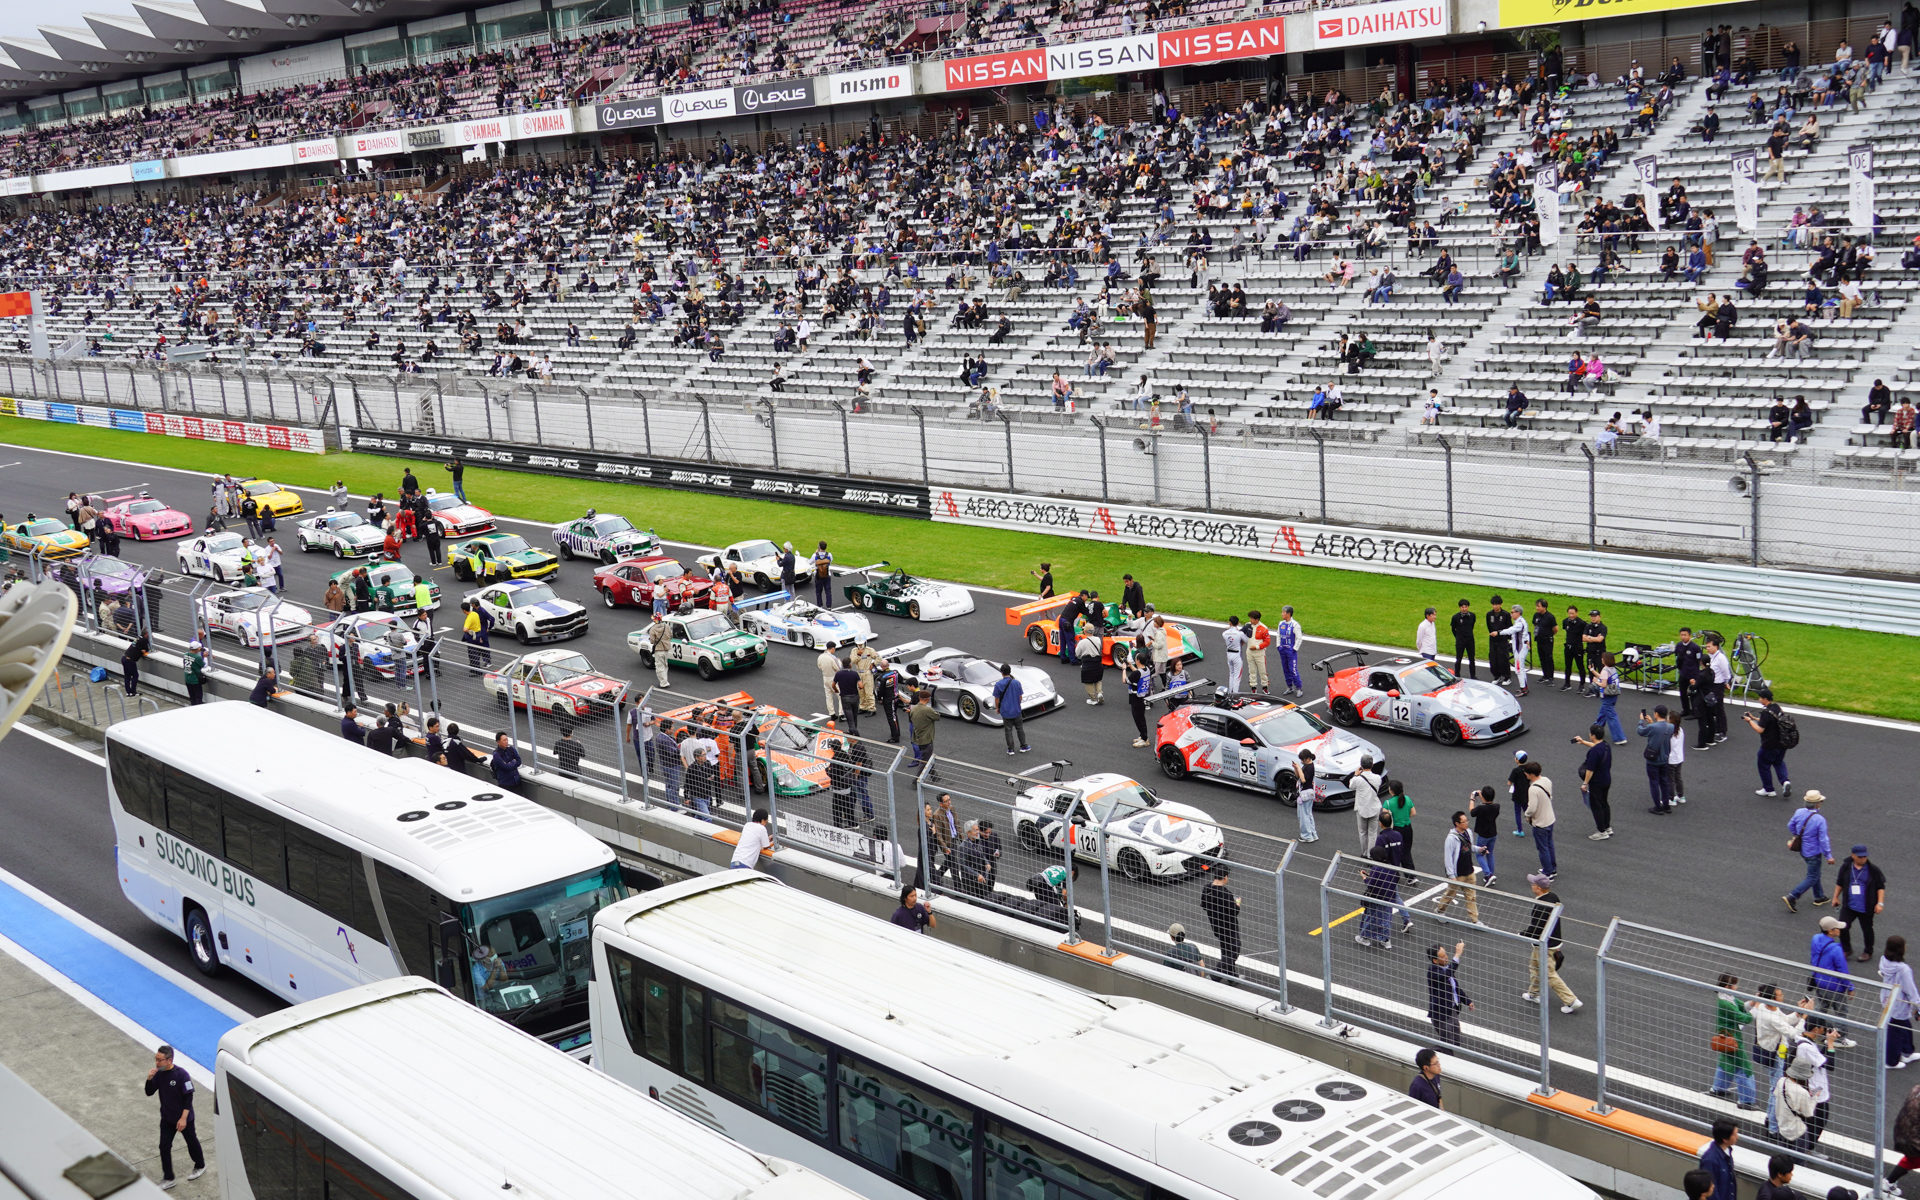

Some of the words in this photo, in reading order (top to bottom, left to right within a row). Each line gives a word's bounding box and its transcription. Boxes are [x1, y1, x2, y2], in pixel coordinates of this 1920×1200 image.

[1347, 6, 1442, 36] DAIHATSU
[1162, 25, 1279, 59] NISSAN
[1050, 42, 1154, 71] NISSAN
[949, 55, 1043, 84] NISSAN
[840, 75, 900, 94] nismo
[759, 88, 807, 103] LEXUS
[617, 106, 657, 121] LEXUS
[685, 98, 728, 112] LEXUS
[471, 122, 502, 139] YAMAHA
[531, 114, 565, 131] YAMAHA
[306, 143, 337, 157] DAIHATSU
[366, 136, 399, 151] DAIHATSU
[965, 496, 1011, 520] AERO
[1013, 502, 1080, 528] TOYOTA
[1124, 513, 1178, 539] AERO
[1181, 519, 1259, 548] TOYOTA
[1311, 532, 1376, 561] AERO
[1380, 539, 1475, 573] TOYOTA
[632, 588, 641, 602] 75
[865, 596, 871, 607] 7
[219, 612, 225, 624] 7
[498, 611, 505, 626] 5
[1050, 630, 1060, 646] 20
[672, 643, 683, 660] 33
[1394, 705, 1409, 721] 12
[1223, 765, 1239, 773] RACING
[1241, 758, 1257, 776] 55
[1080, 834, 1097, 853] 120
[155, 831, 218, 887] SUSONO
[222, 865, 256, 907] BUS
